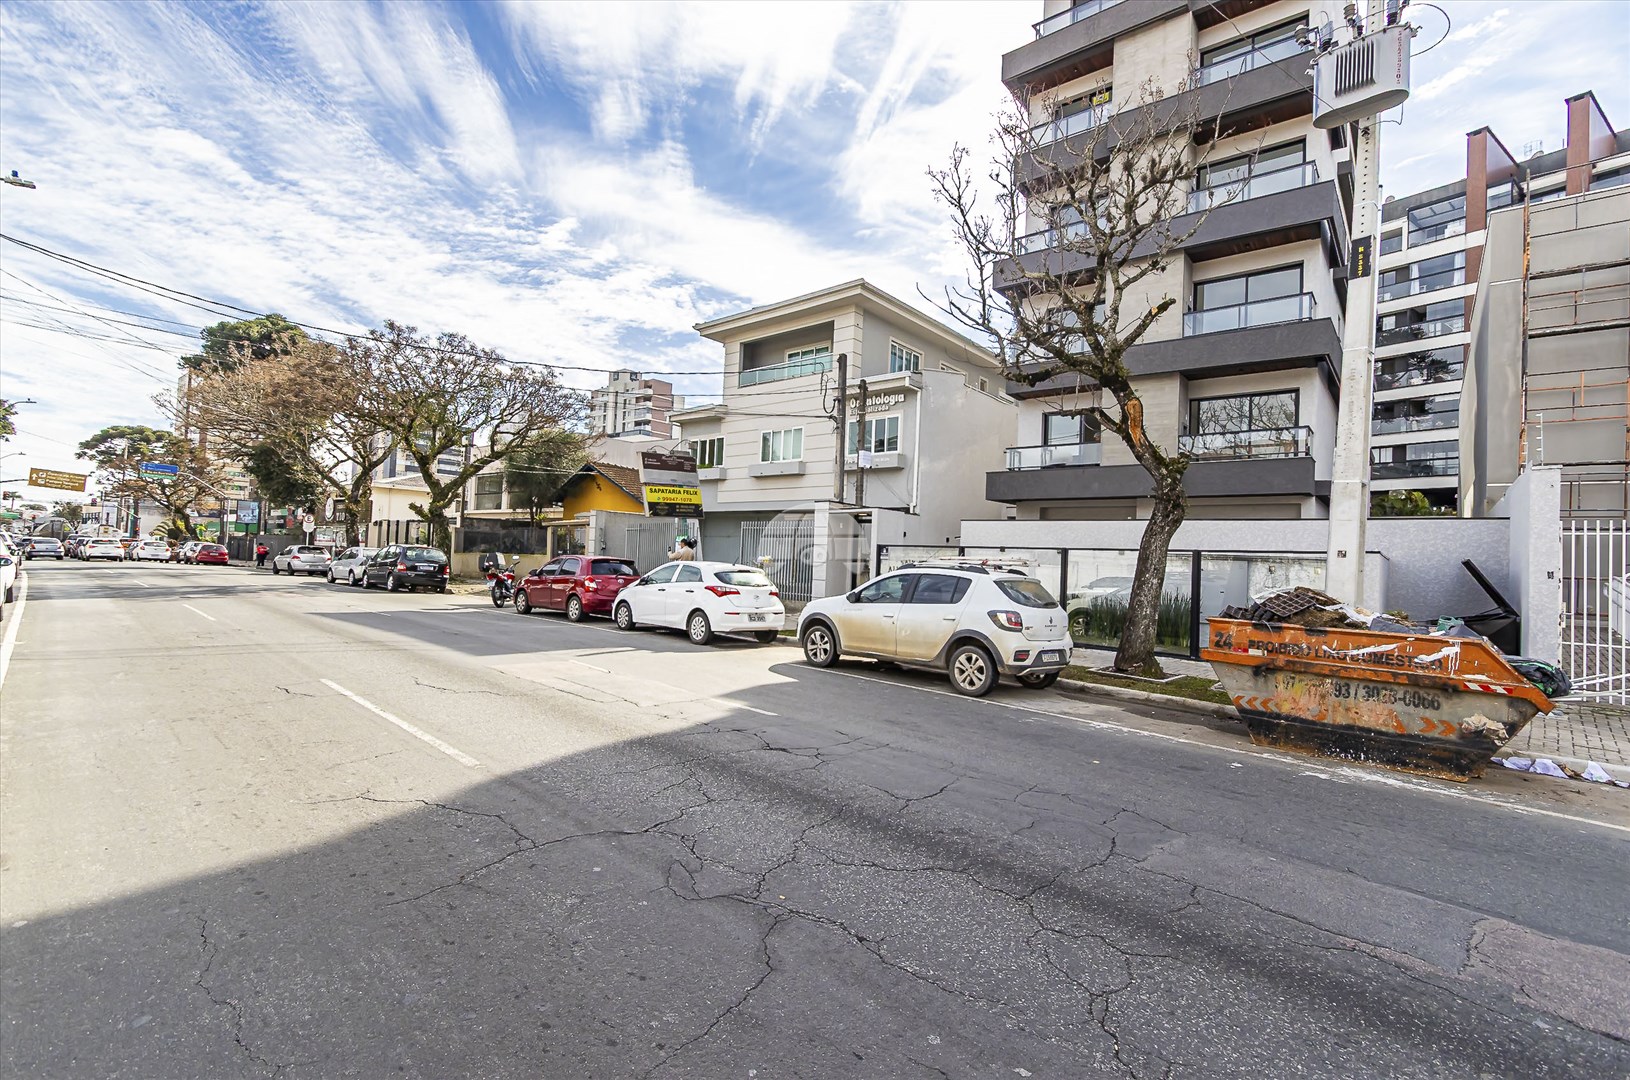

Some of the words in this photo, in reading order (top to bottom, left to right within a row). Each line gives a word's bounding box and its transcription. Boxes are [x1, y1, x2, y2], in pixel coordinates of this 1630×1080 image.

[649, 488, 682, 496] SAPATARIA
[1214, 631, 1233, 649] 24
[1248, 639, 1312, 657] PROIBIDO
